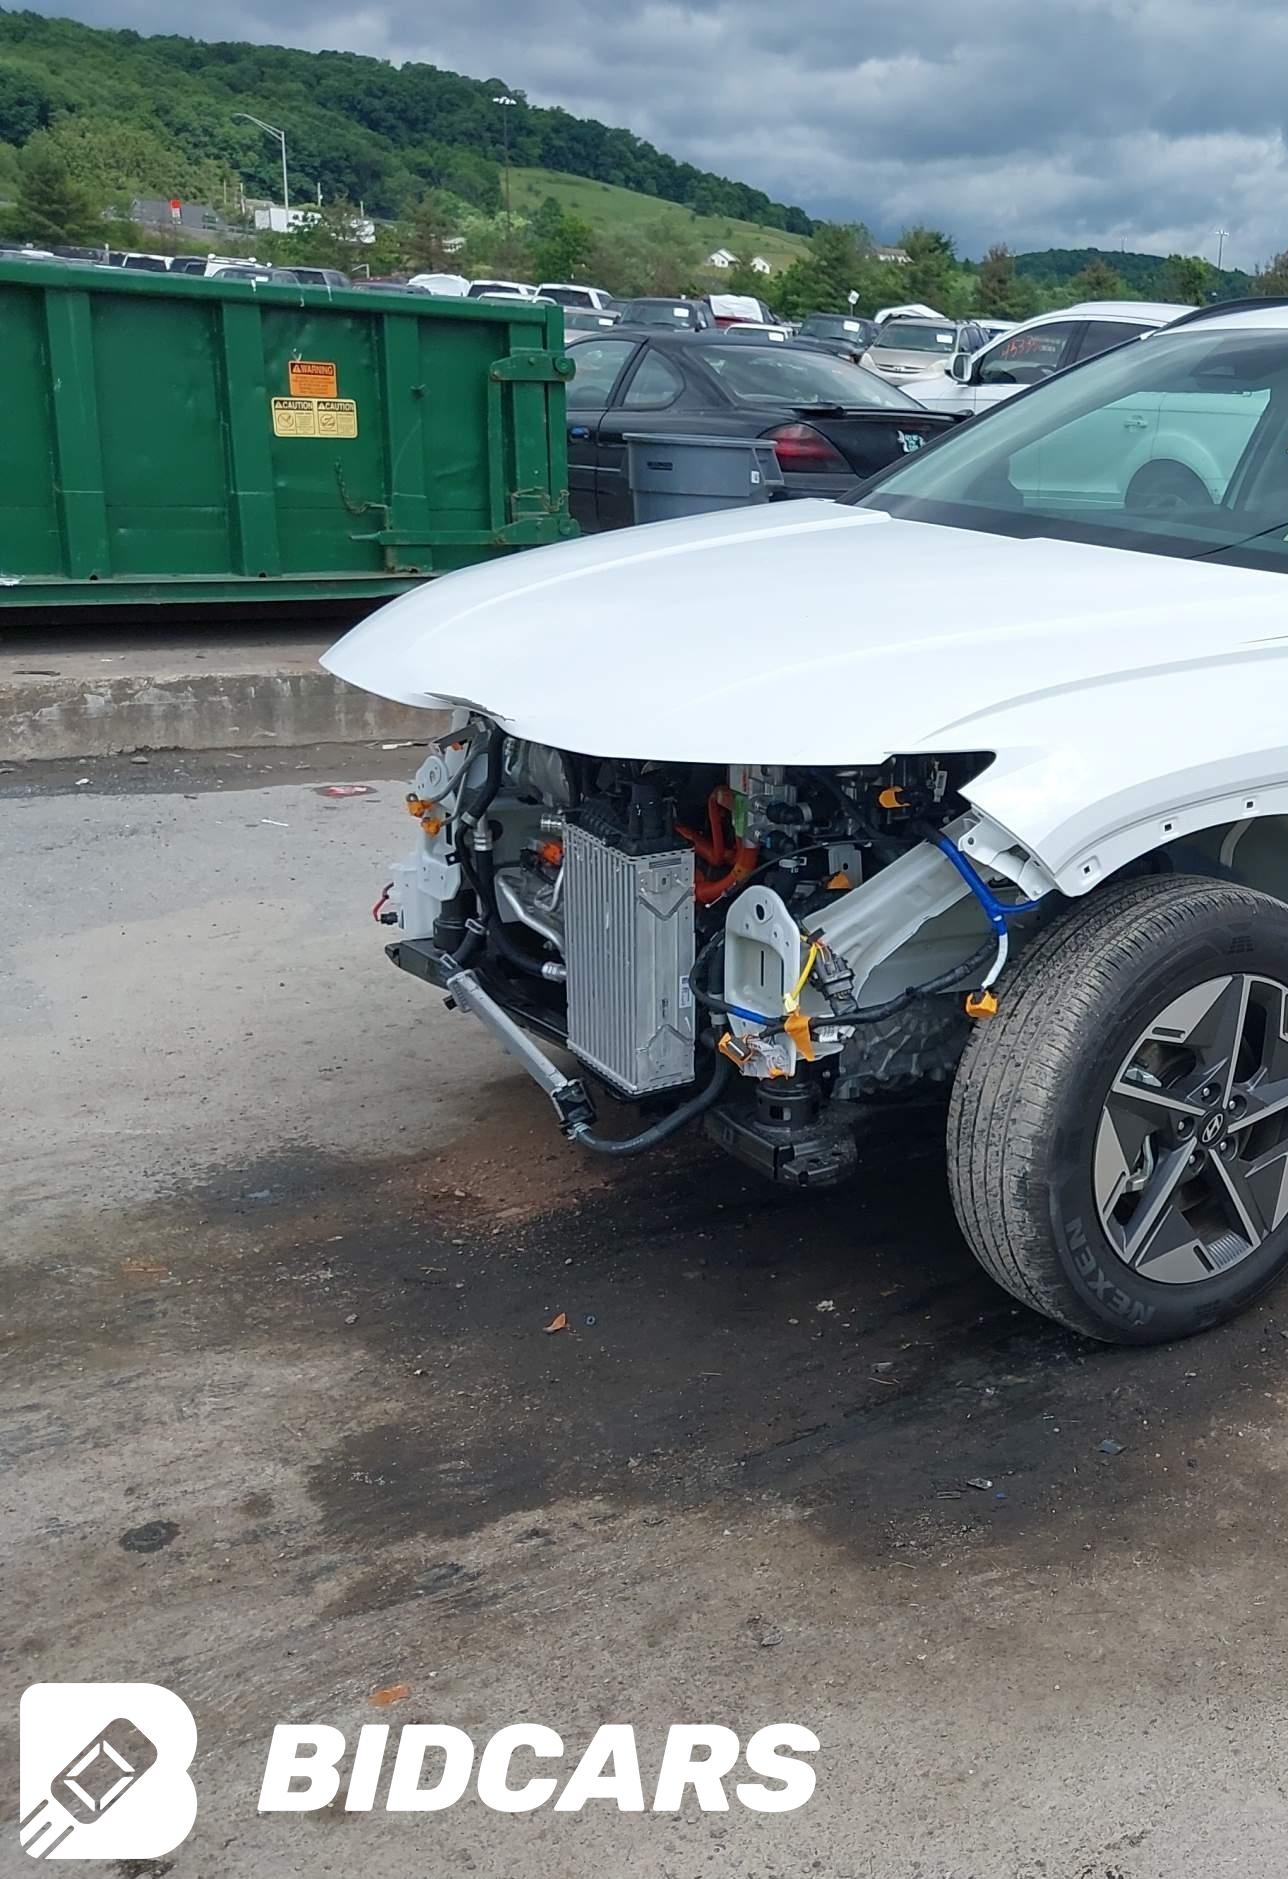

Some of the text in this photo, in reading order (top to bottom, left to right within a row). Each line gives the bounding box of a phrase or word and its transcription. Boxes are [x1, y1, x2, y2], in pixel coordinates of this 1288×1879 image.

[300, 364, 333, 375] WARNING
[282, 401, 313, 410] CAUTION
[325, 402, 355, 411] CAUTION
[1064, 1216, 1155, 1324] NEXEN
